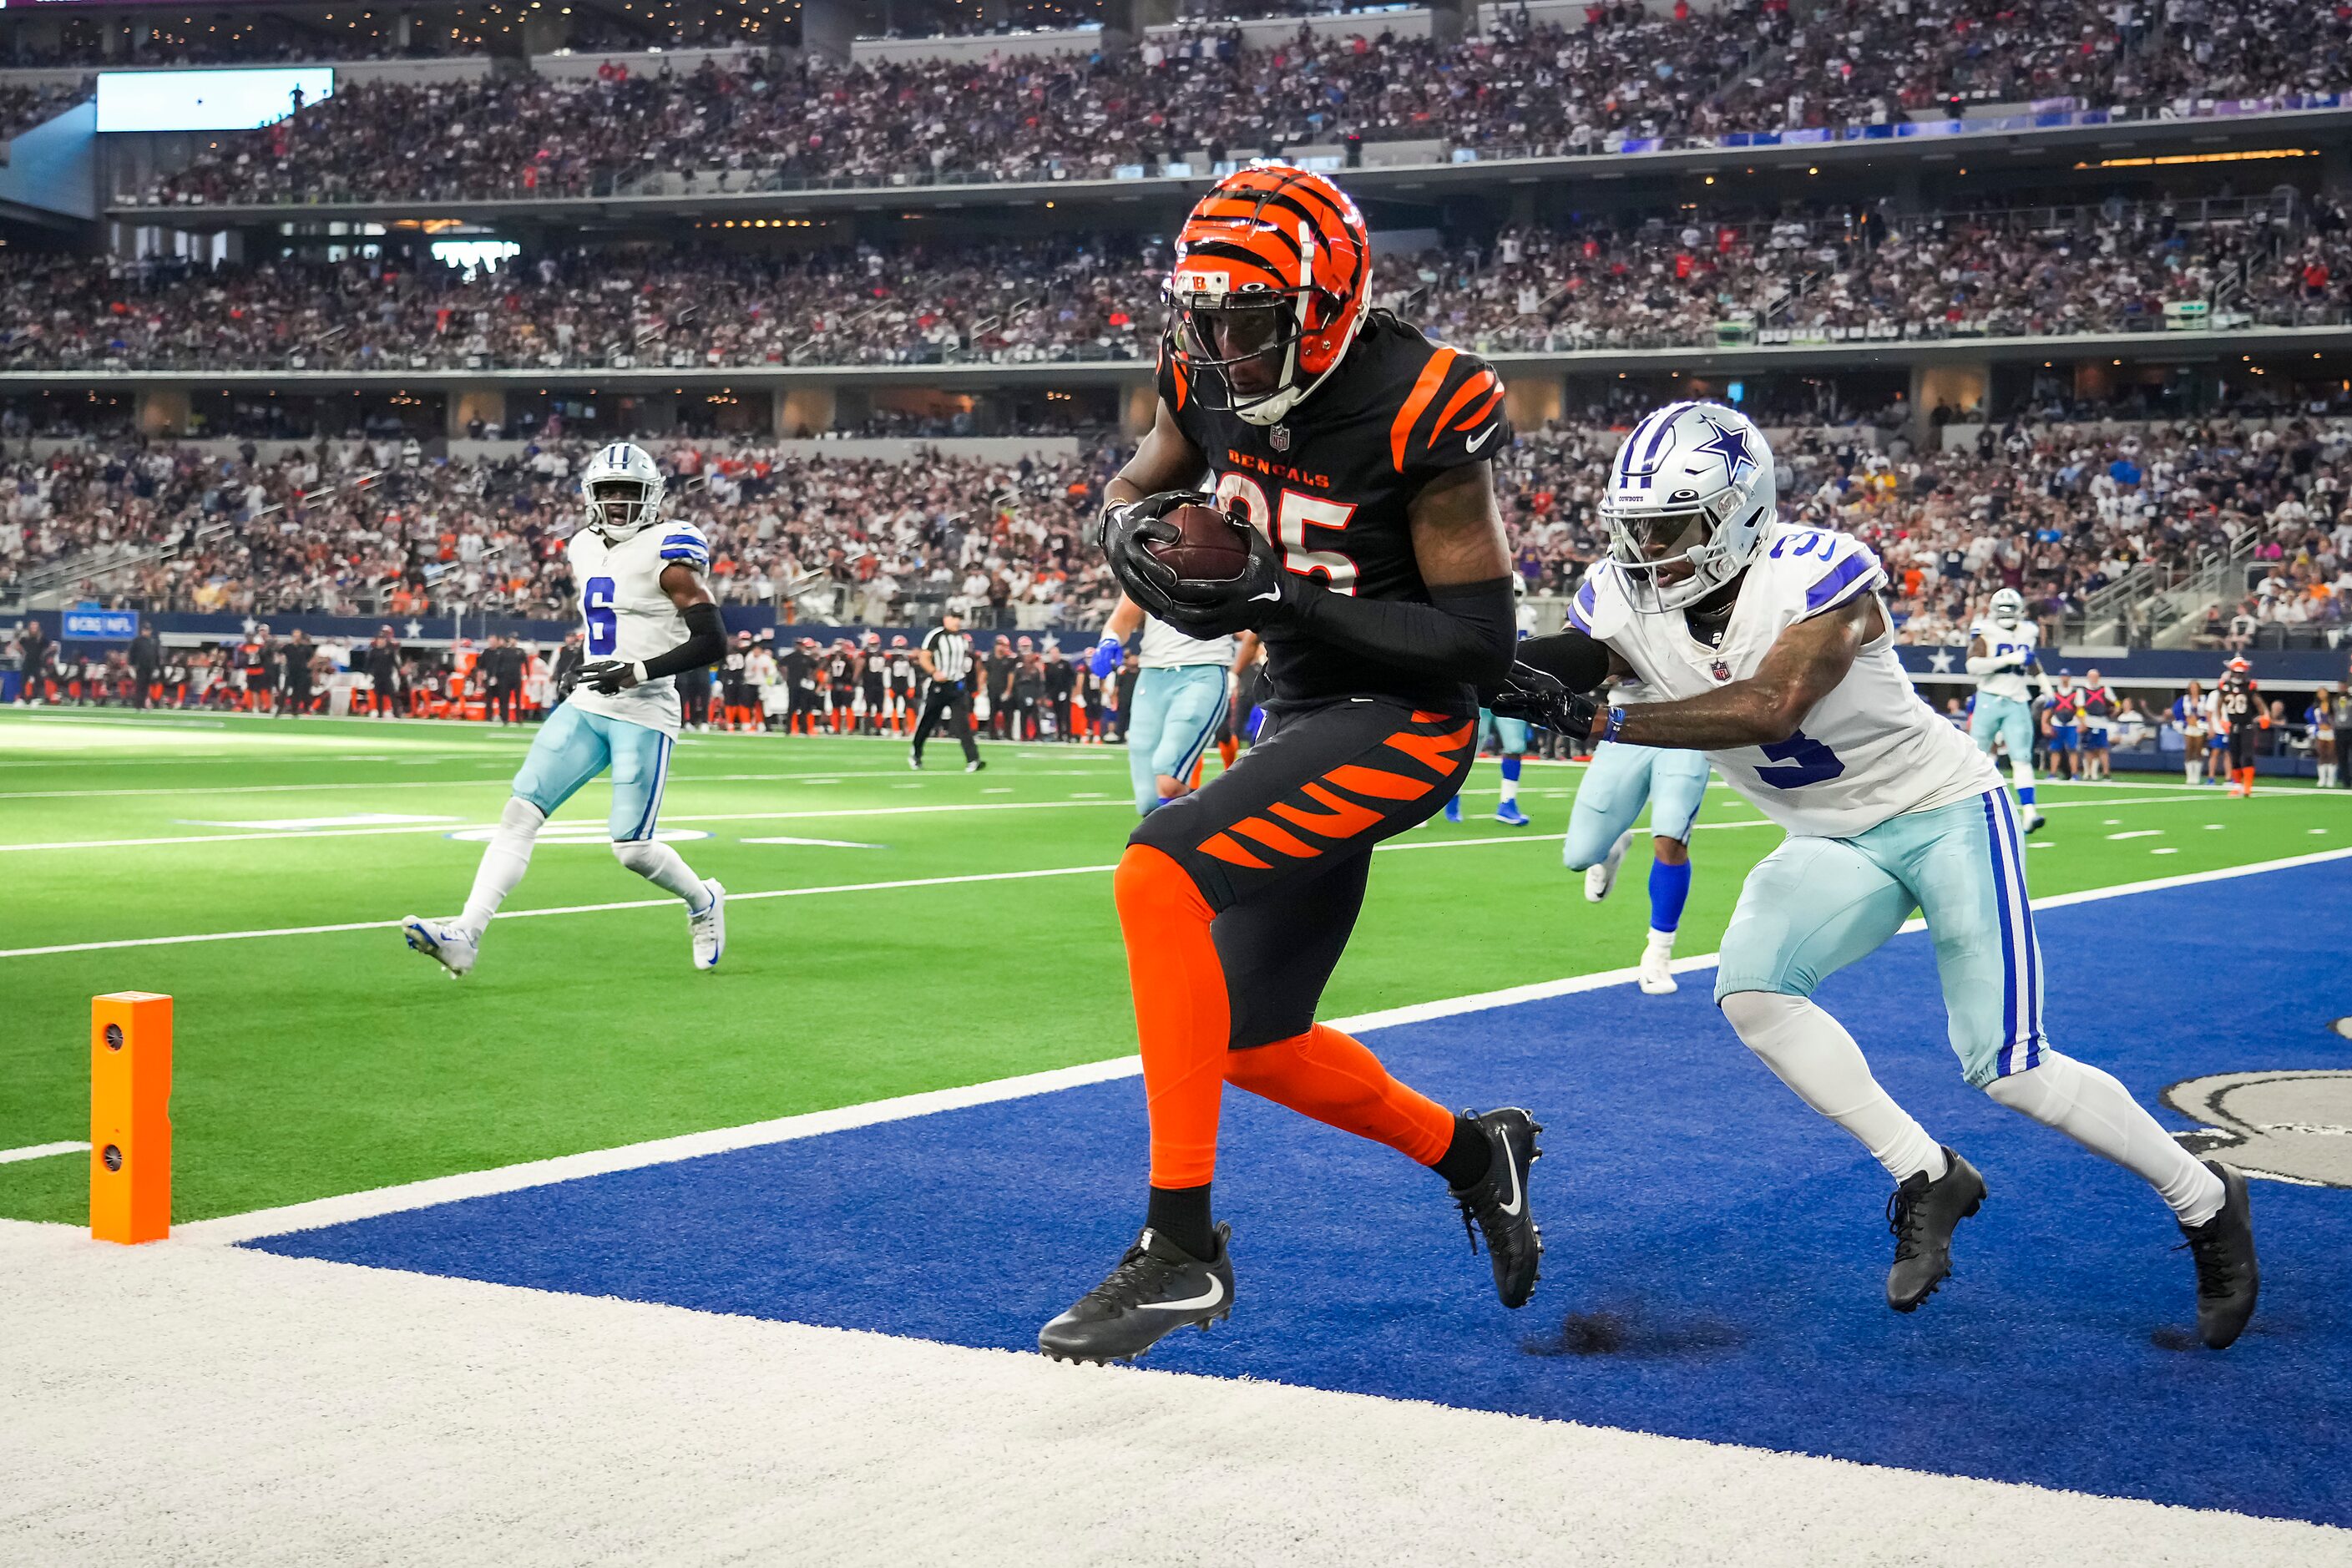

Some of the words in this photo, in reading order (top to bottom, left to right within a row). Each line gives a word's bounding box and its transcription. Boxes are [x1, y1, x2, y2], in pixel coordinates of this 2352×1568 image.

[1228, 449, 1329, 488] BENGALS
[584, 577, 616, 655] 6
[1714, 669, 1729, 680] NFL
